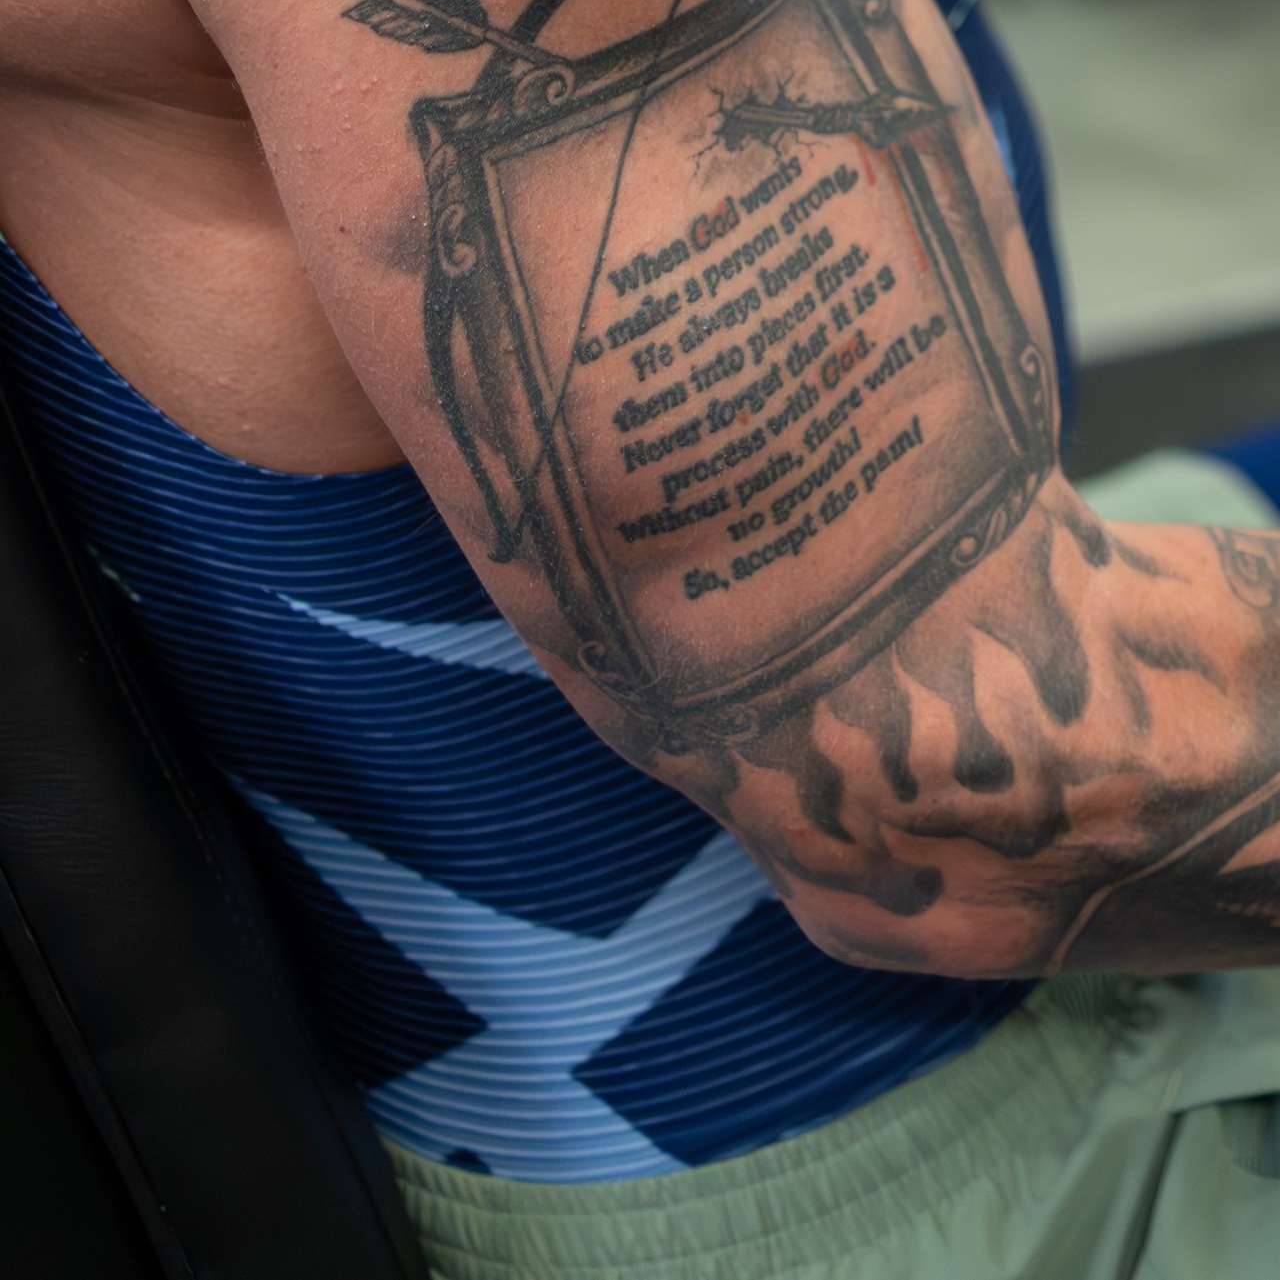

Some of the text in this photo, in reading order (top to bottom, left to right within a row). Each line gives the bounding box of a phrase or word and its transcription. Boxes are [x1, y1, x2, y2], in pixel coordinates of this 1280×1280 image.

[574, 336, 604, 365] to
[606, 291, 681, 350] make
[684, 277, 702, 303] a
[702, 224, 780, 298] person
[607, 156, 802, 298] When God wants
[631, 226, 833, 382] He always breaks
[612, 244, 870, 432] them into pieces first.
[620, 265, 896, 473] Never forget that it is a
[661, 328, 877, 504] process with God.
[803, 386, 863, 453] there
[863, 337, 914, 392] will
[910, 314, 946, 353] be
[683, 415, 923, 600] So, accept the pain!
[727, 426, 861, 542] no growth!
